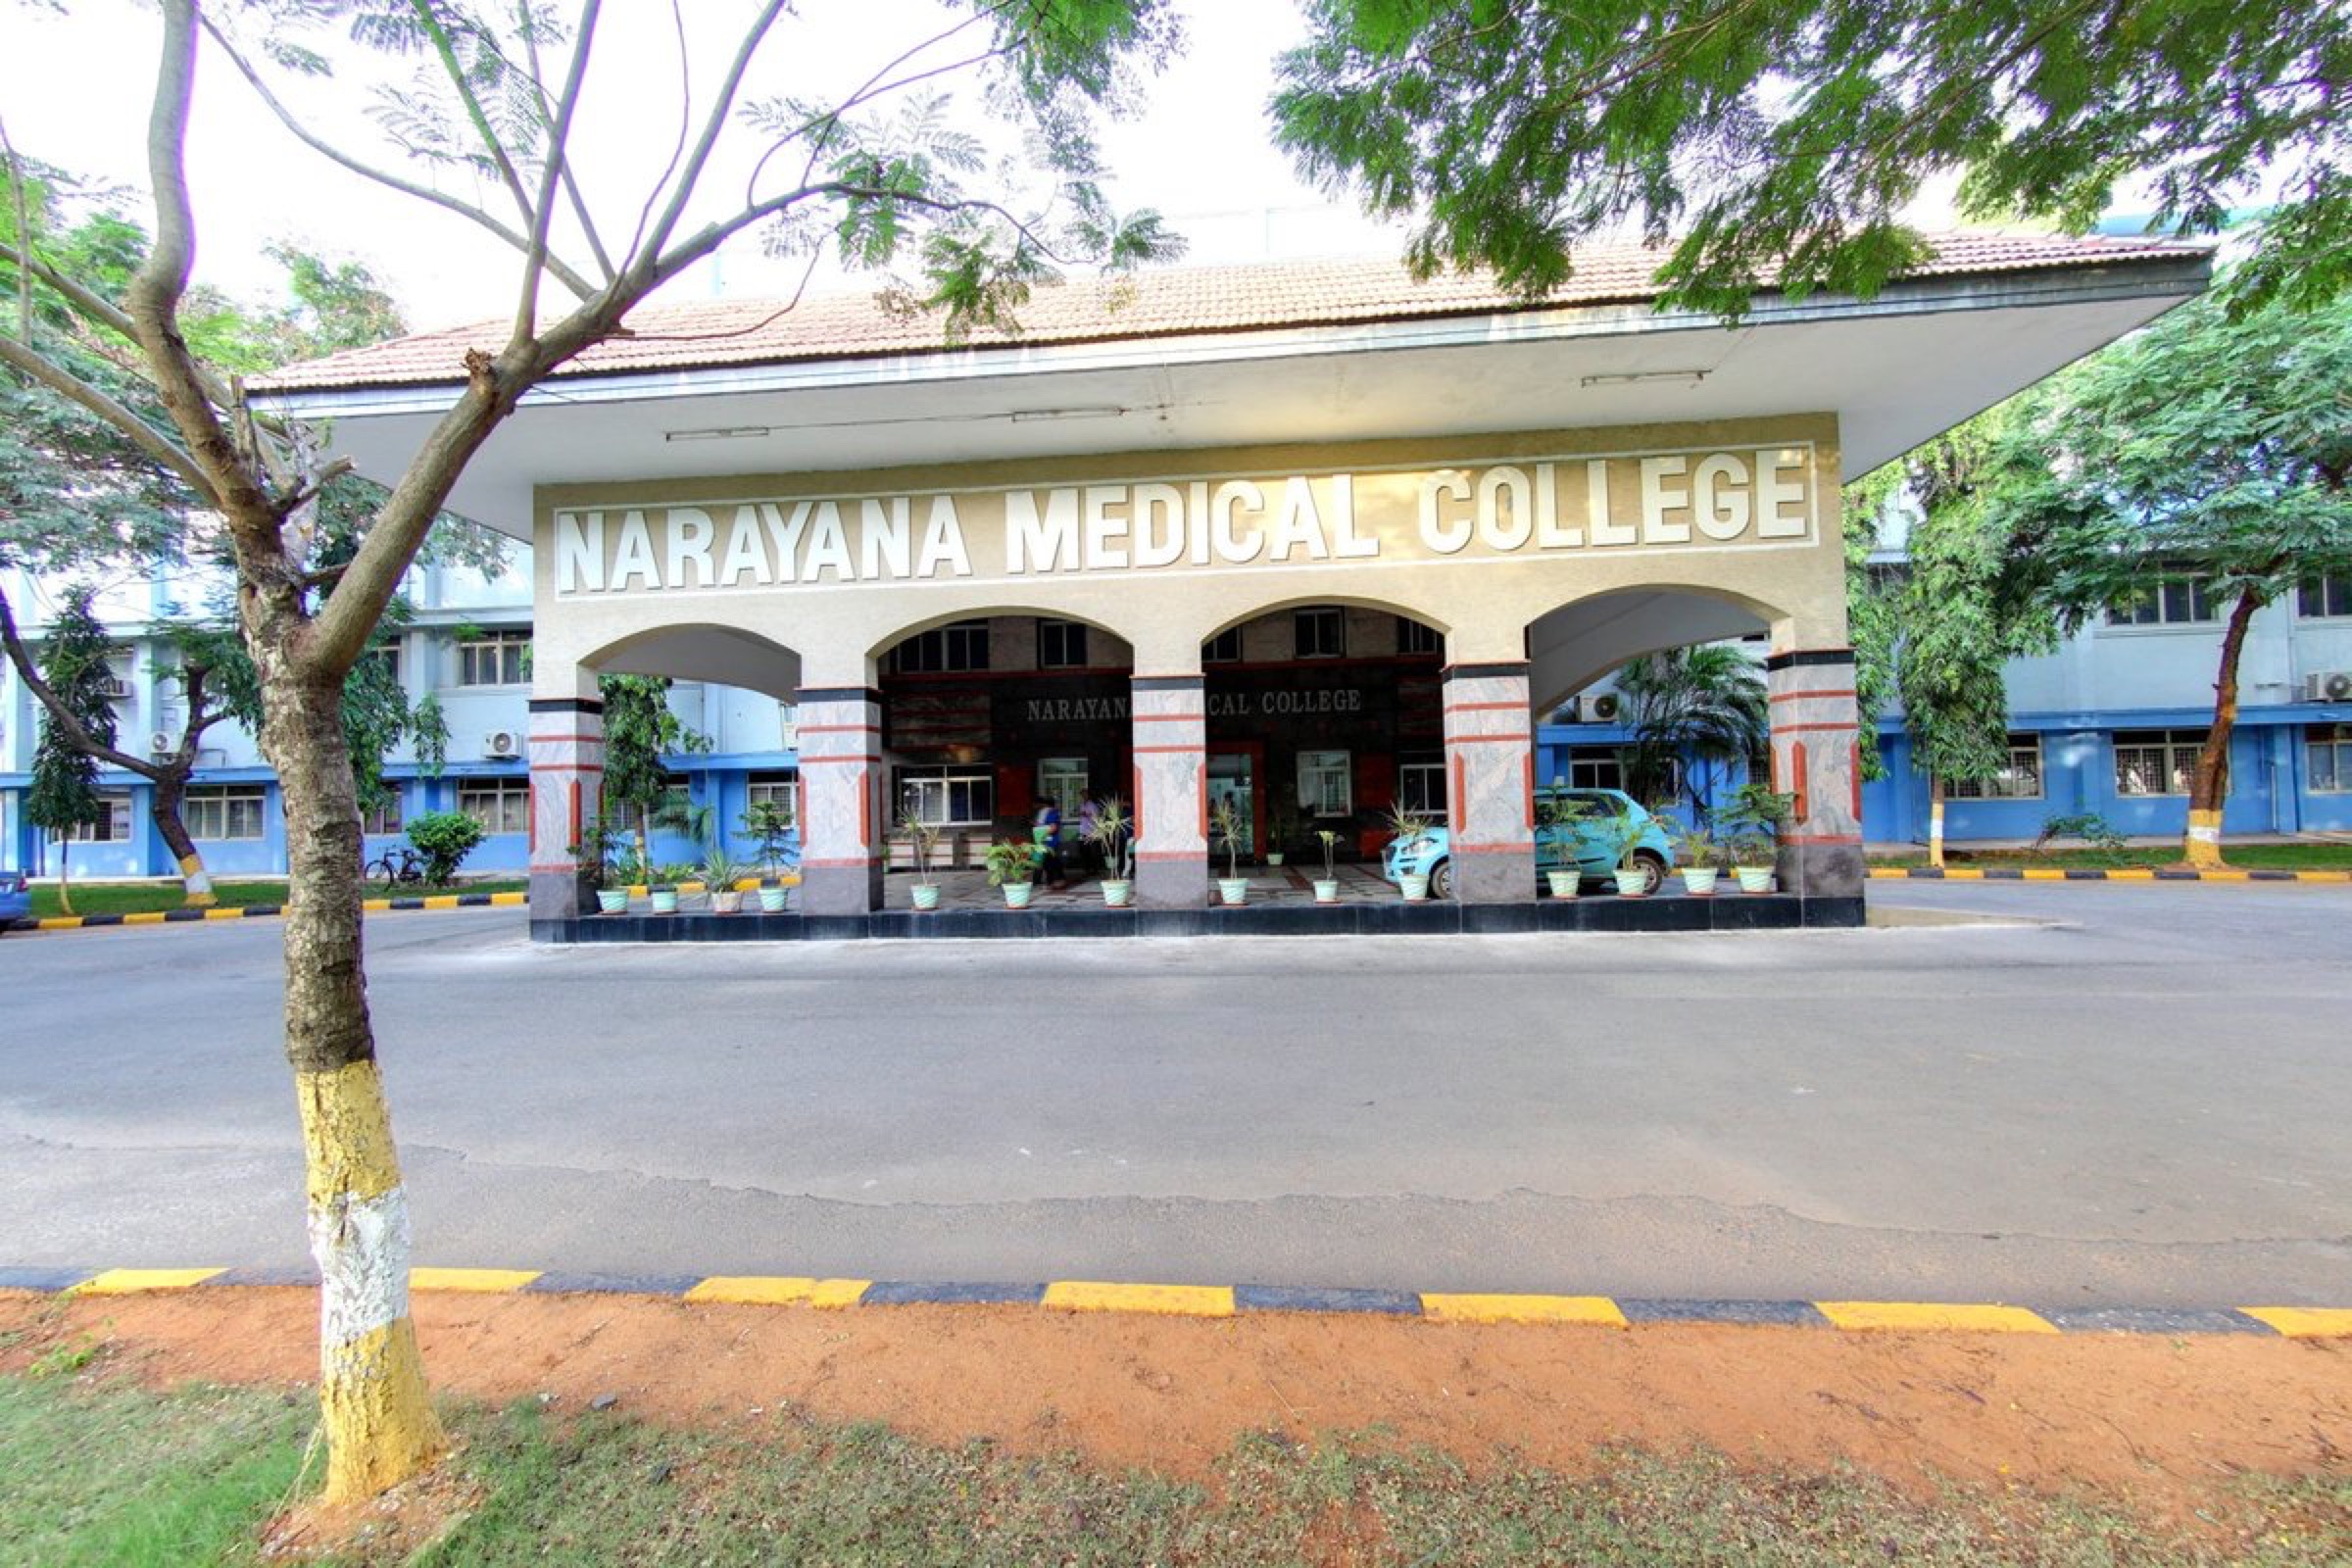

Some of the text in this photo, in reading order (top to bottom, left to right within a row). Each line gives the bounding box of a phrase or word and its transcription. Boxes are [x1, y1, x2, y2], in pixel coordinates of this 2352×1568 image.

[557, 449, 1808, 593] NARAYANA MEDICAL COLLEGE
[1027, 697, 1132, 722] NARAYAN
[1261, 689, 1362, 714] COLLEGE
